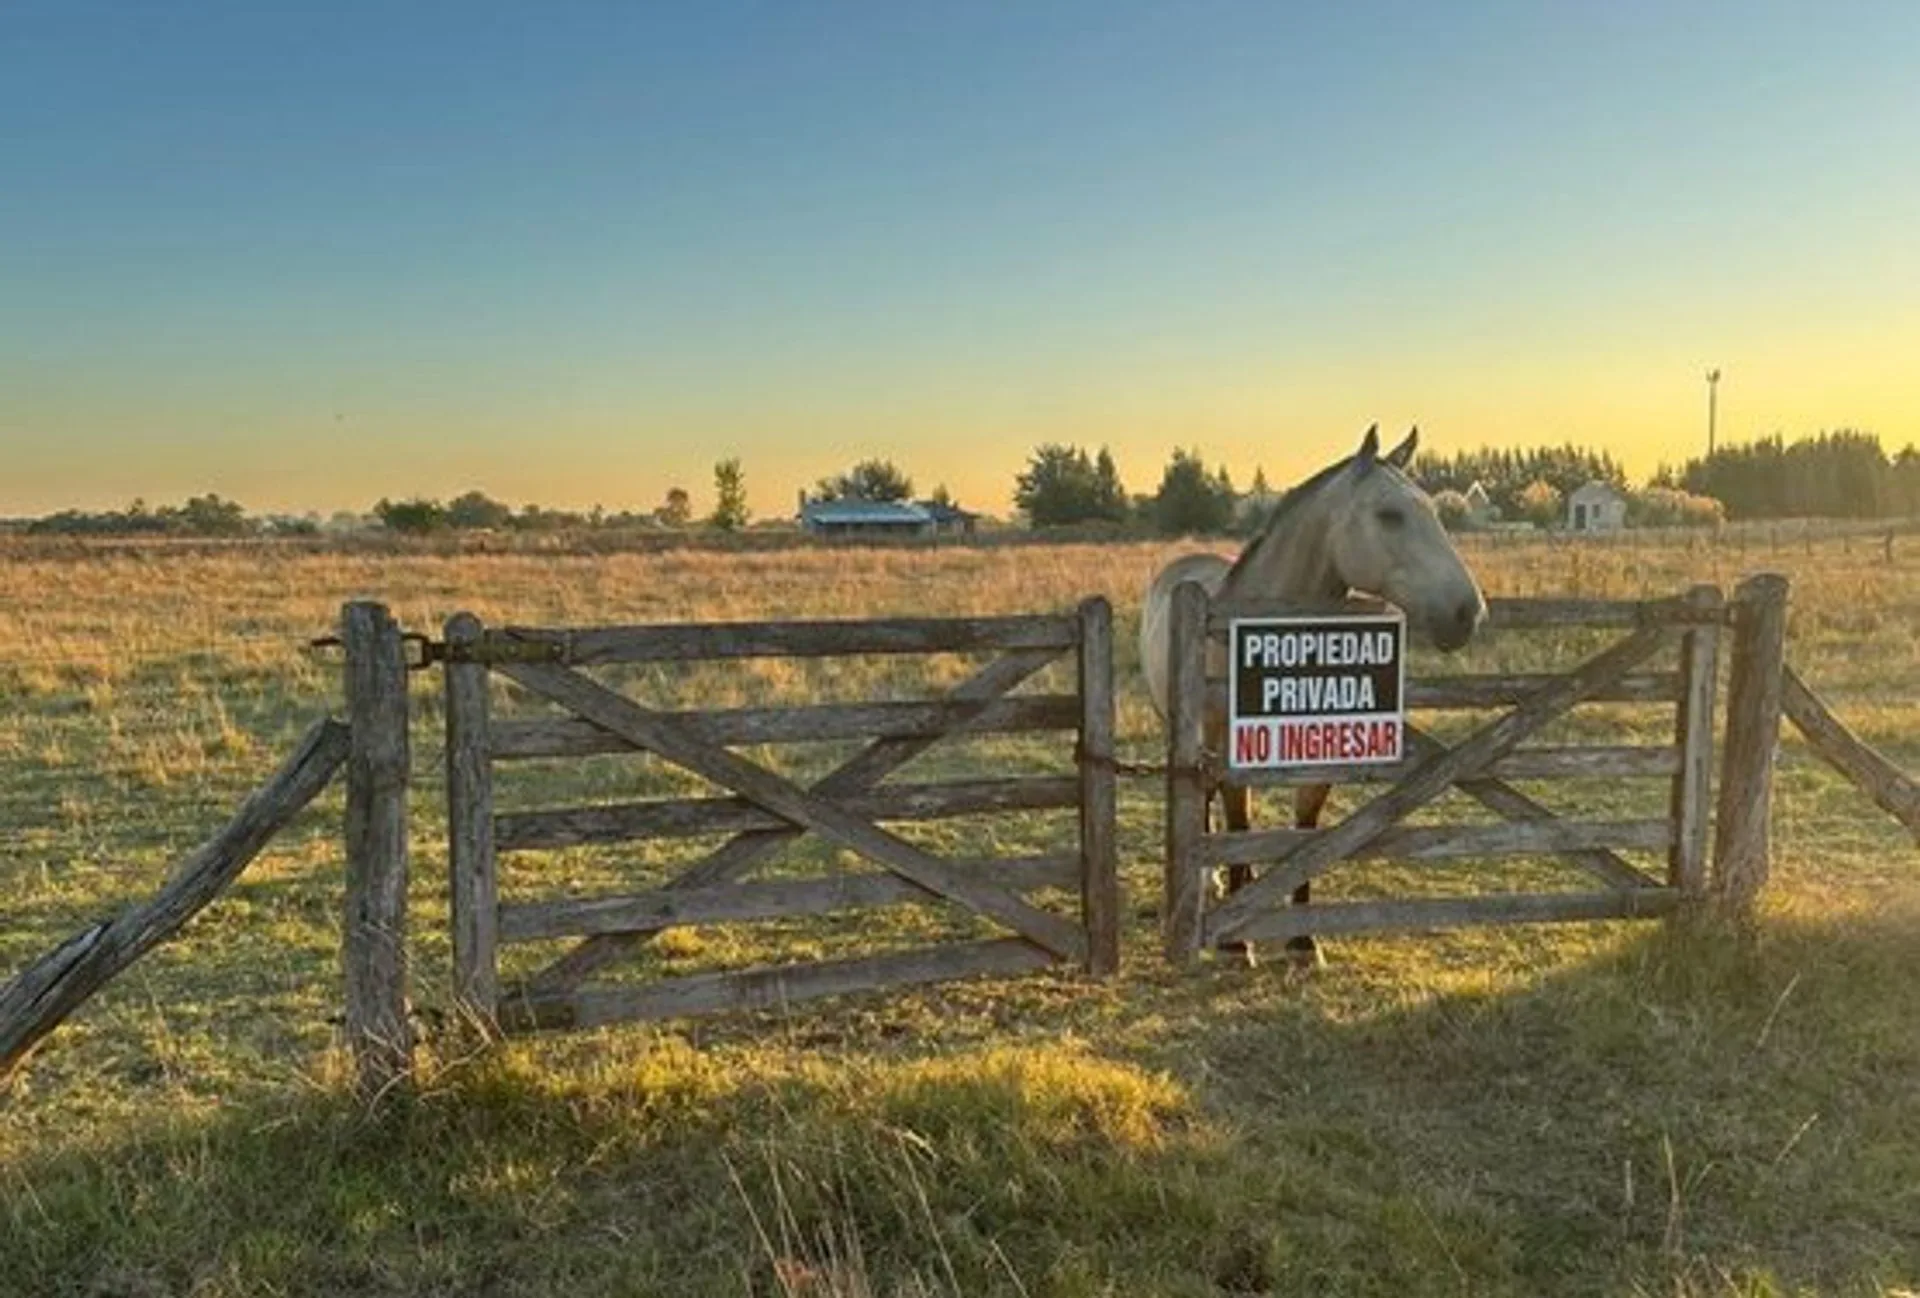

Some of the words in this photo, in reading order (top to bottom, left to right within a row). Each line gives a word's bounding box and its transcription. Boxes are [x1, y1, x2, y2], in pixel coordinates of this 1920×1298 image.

[1244, 631, 1394, 668] PROPIEDAD
[1262, 675, 1376, 712] PRIVADA
[1236, 724, 1270, 763] NO
[1279, 721, 1397, 761] INGRESAR
